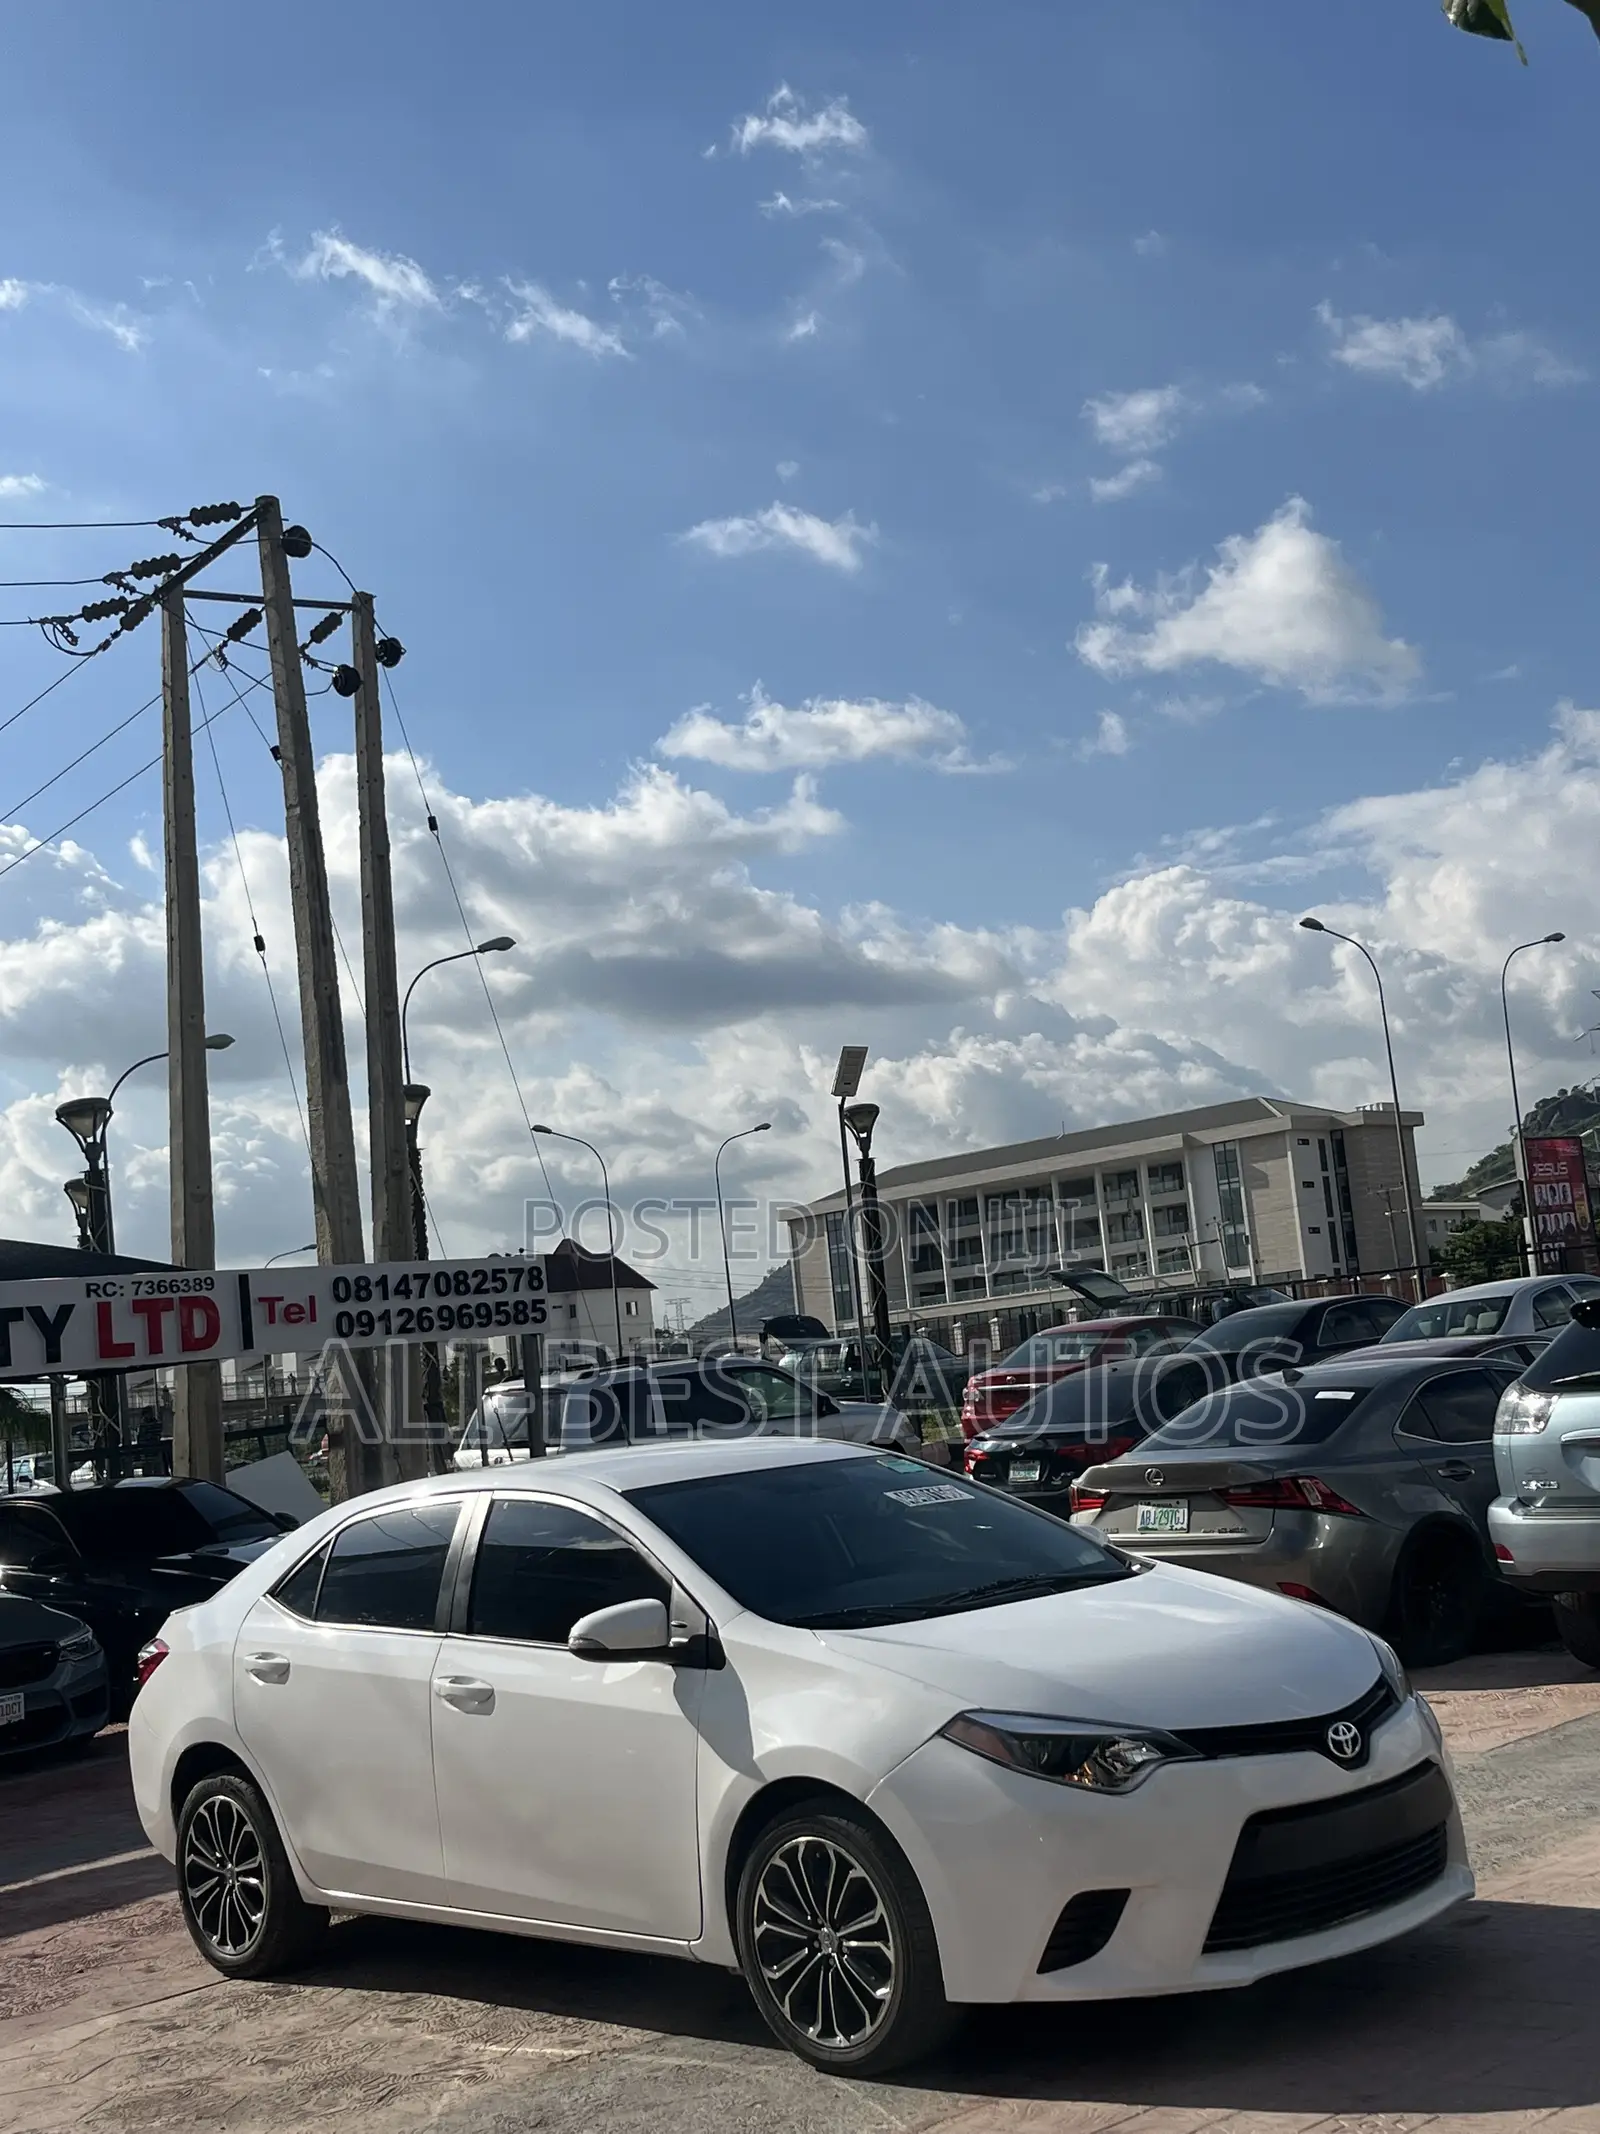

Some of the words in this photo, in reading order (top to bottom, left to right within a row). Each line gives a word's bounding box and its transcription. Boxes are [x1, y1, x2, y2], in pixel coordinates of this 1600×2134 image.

[1532, 1161, 1568, 1176] JESUS
[85, 1282, 125, 1298] RC:
[131, 1276, 215, 1296] 7366389
[332, 1266, 545, 1303] 08147082578
[257, 1295, 317, 1325] Tel
[335, 1299, 548, 1338] 09126969585
[96, 1295, 221, 1359] LTD
